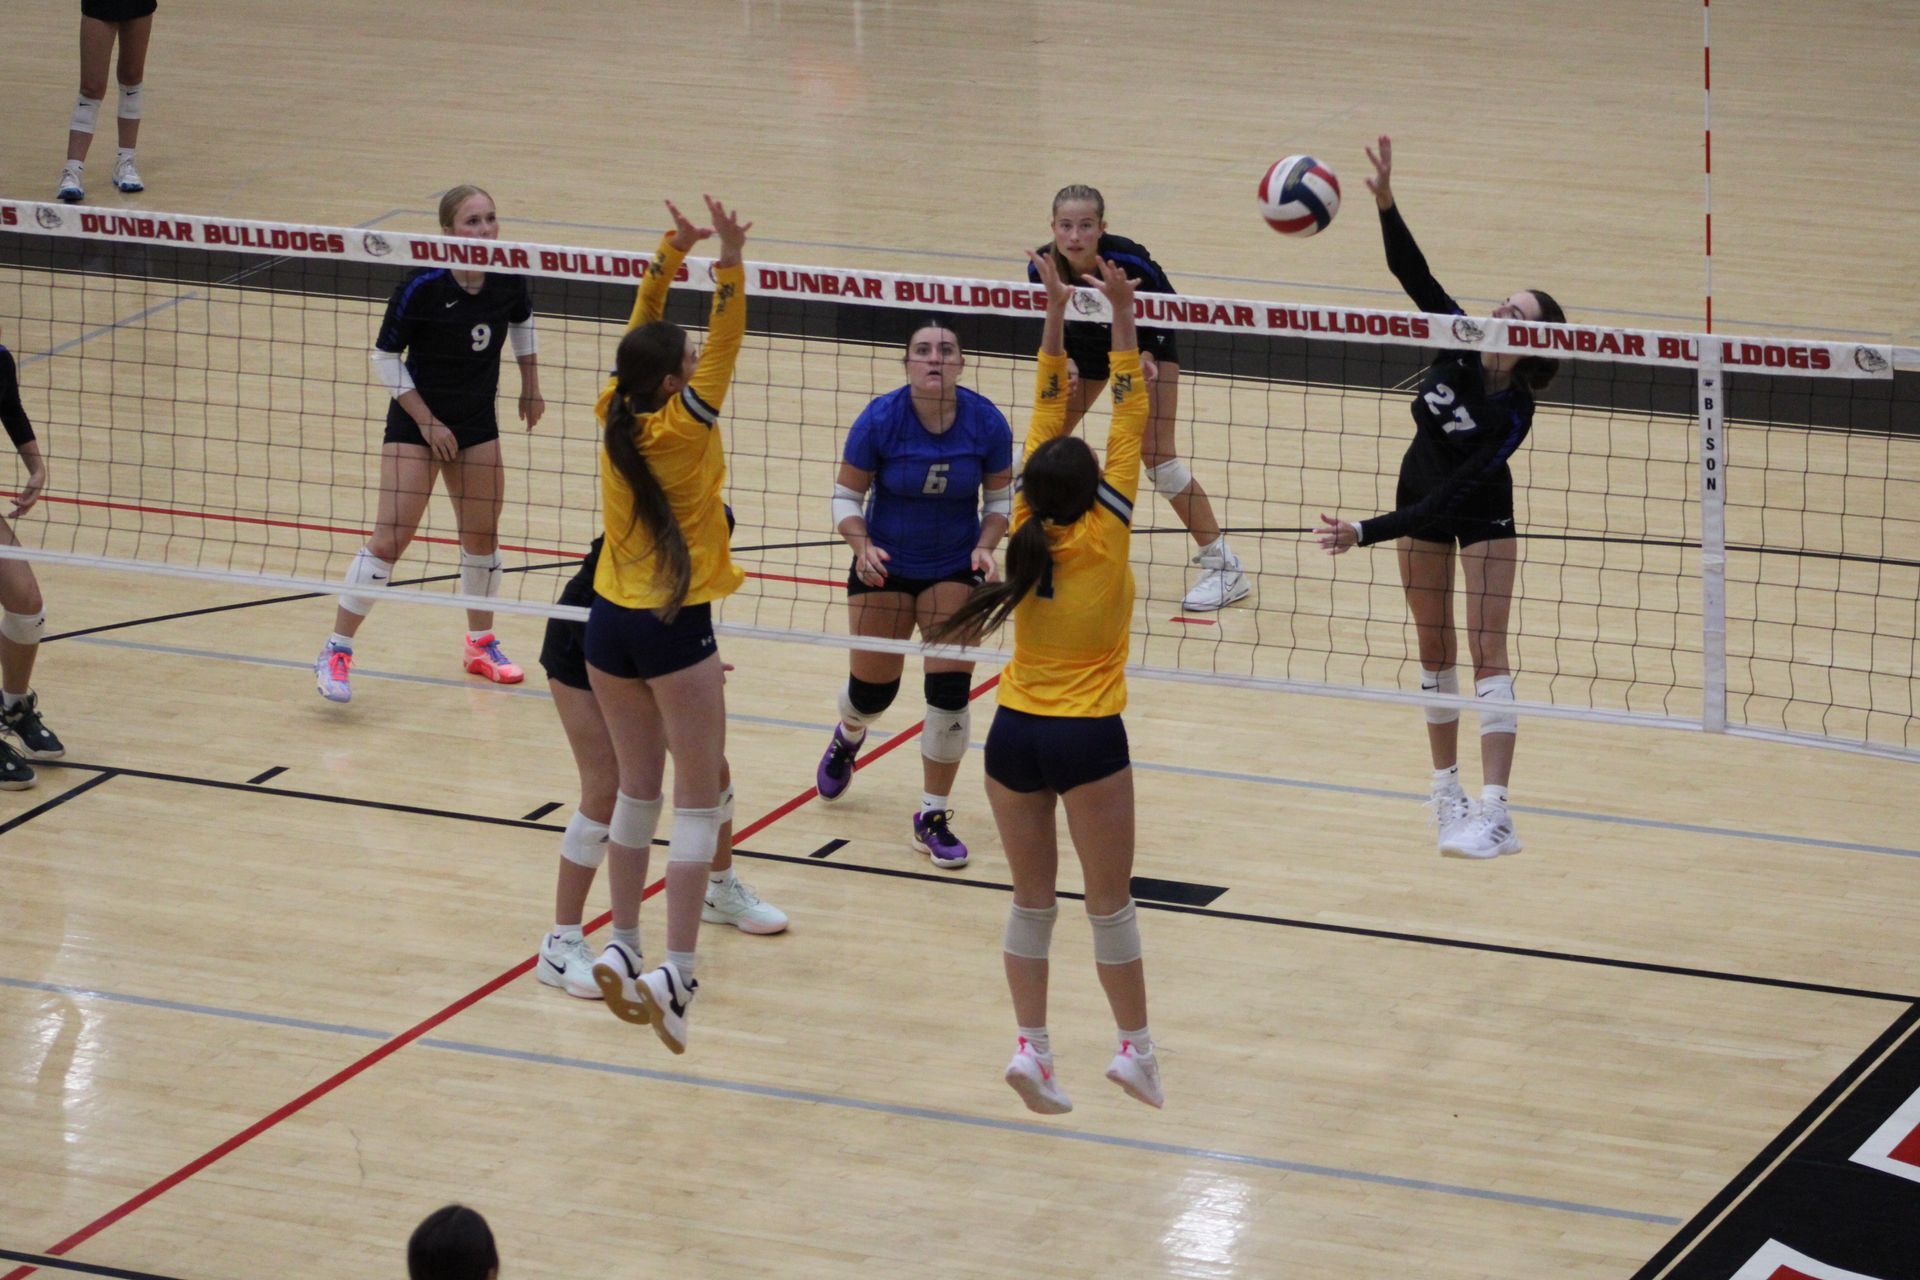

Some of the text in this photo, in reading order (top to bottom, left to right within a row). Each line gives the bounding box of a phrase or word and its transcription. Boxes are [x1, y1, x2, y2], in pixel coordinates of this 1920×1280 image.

[81, 214, 345, 254] DUNBAR BULLDOGS
[411, 241, 529, 269] DUNBAR
[540, 252, 689, 283] BULLDOS
[760, 269, 882, 299] DUNBAR
[895, 281, 1049, 312] BULLDOGS
[471, 323, 492, 352] 9
[1267, 308, 1429, 340] BULLDOGS
[1508, 326, 1829, 369] DUNBAR BULDOGS
[1423, 383, 1477, 434] 27
[1704, 397, 1717, 491] BISON
[922, 463, 950, 495] 6
